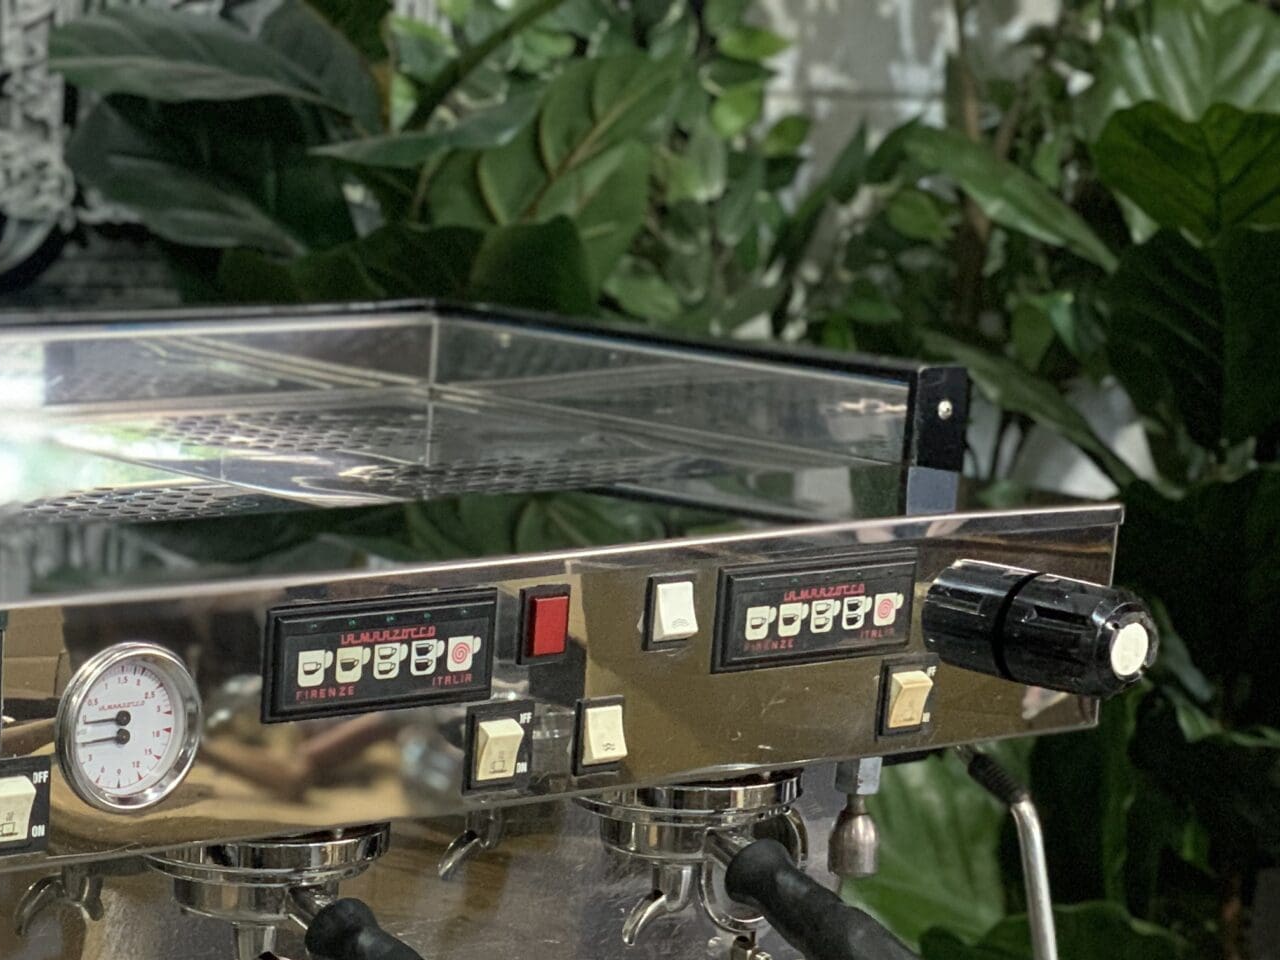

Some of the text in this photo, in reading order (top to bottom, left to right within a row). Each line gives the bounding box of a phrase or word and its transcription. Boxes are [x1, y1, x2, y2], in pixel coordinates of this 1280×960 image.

[432, 673, 473, 687] ITALIA
[296, 686, 355, 701] FIRENZE
[33, 770, 49, 784] OFF
[32, 824, 46, 838] ON
